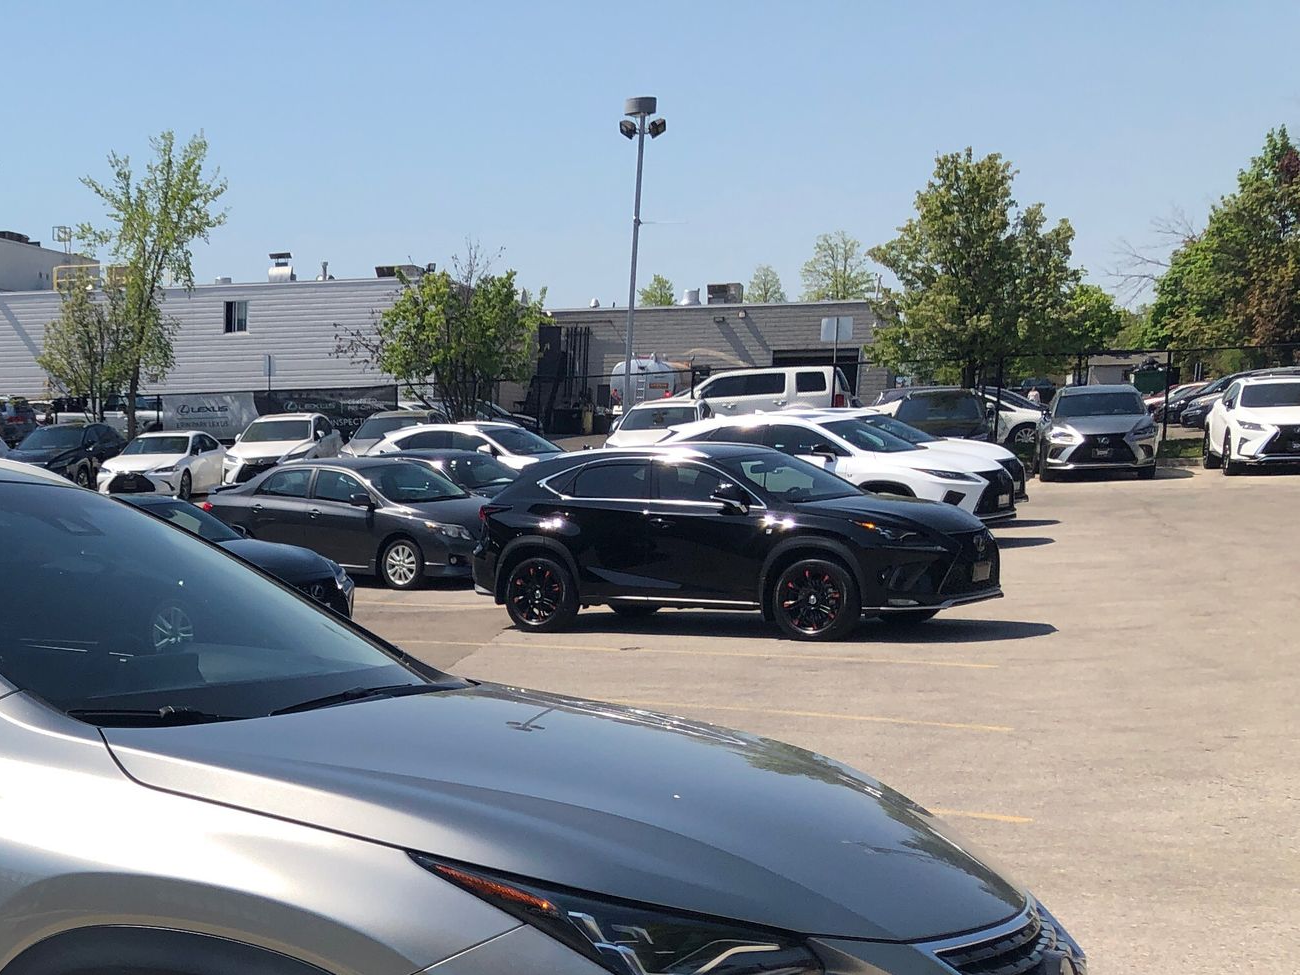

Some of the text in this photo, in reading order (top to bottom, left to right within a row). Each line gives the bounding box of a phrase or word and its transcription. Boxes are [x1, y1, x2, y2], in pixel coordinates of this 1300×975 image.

[190, 405, 229, 413] LEXUS
[298, 402, 336, 410] LEXUS
[209, 420, 229, 428] LEXUS
